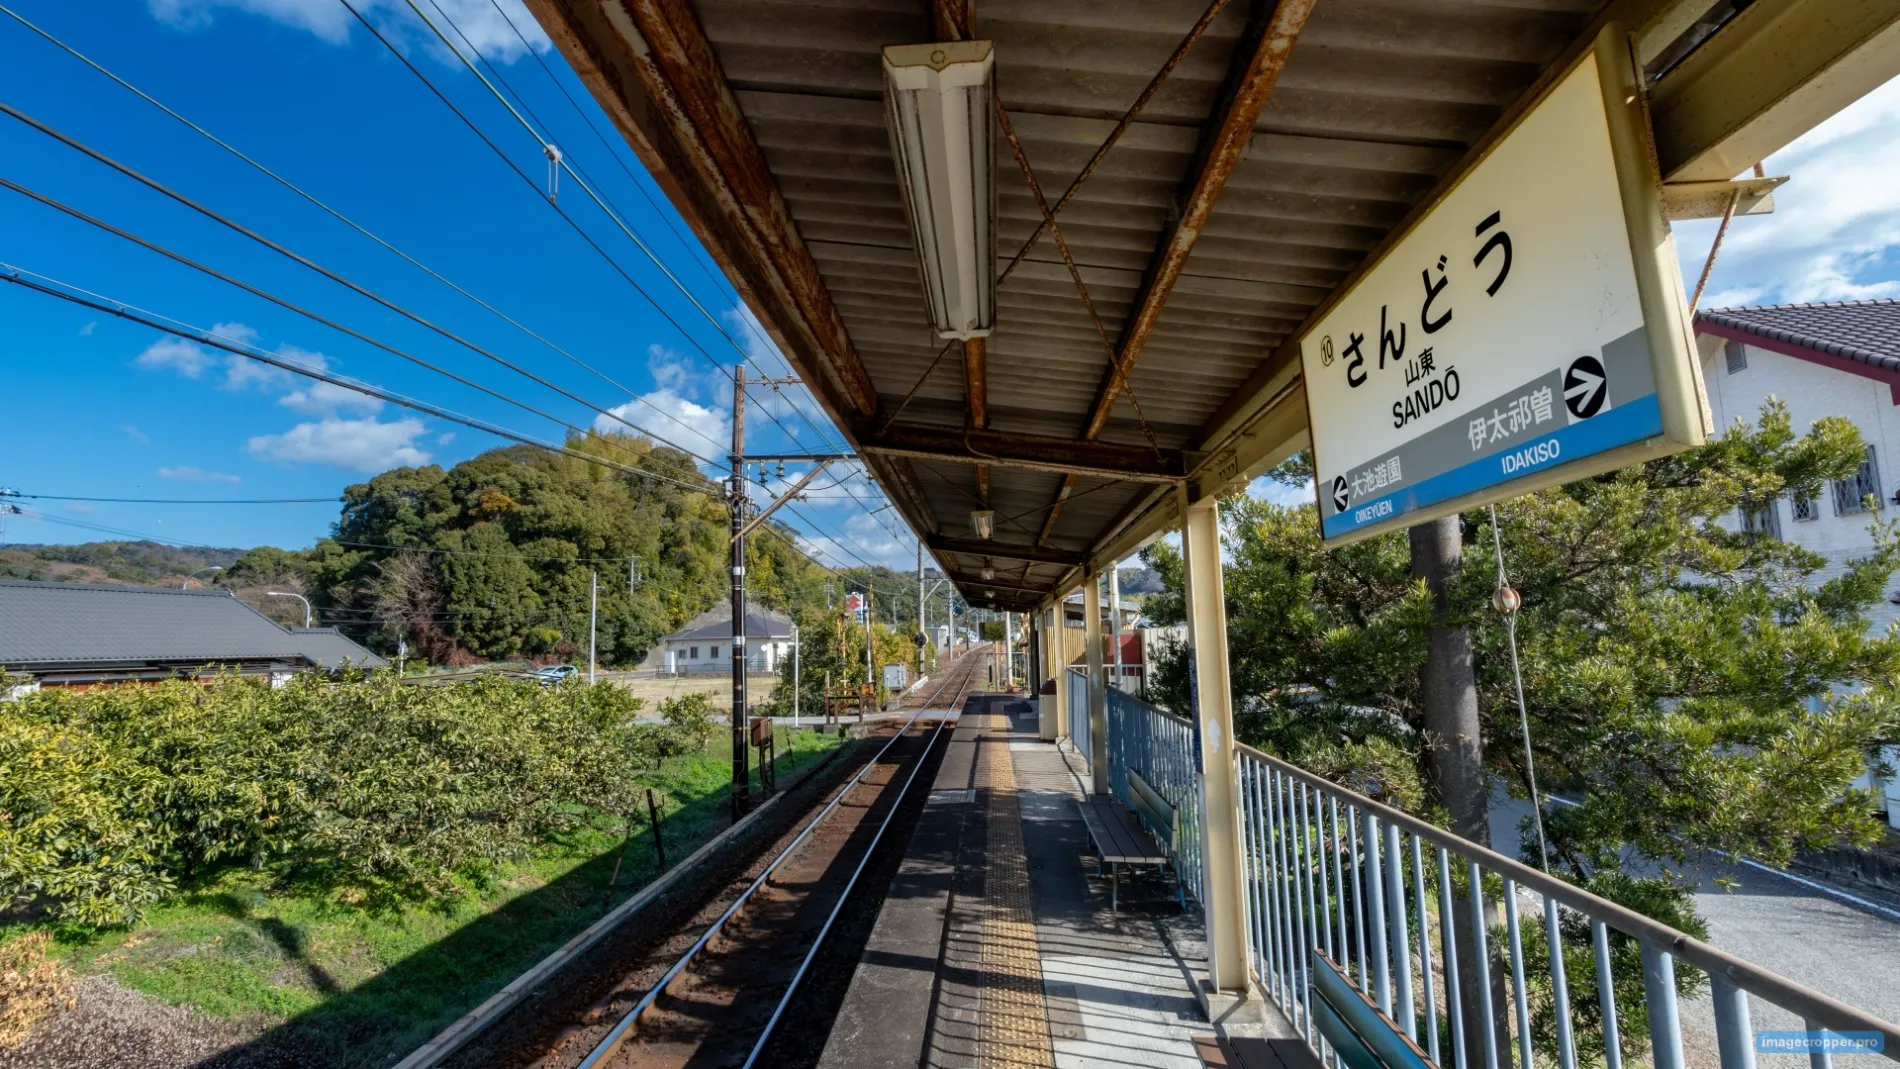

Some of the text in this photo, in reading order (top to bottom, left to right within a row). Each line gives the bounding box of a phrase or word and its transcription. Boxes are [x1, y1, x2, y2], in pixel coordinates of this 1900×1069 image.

[1341, 210, 1513, 388] さんどう
[1405, 347, 1436, 387] 山東
[1393, 365, 1460, 429] SANDŌ
[1468, 385, 1553, 452] 伊太祁曽
[1351, 455, 1402, 499] 大池遊園
[1501, 439, 1560, 475] IDAKISO
